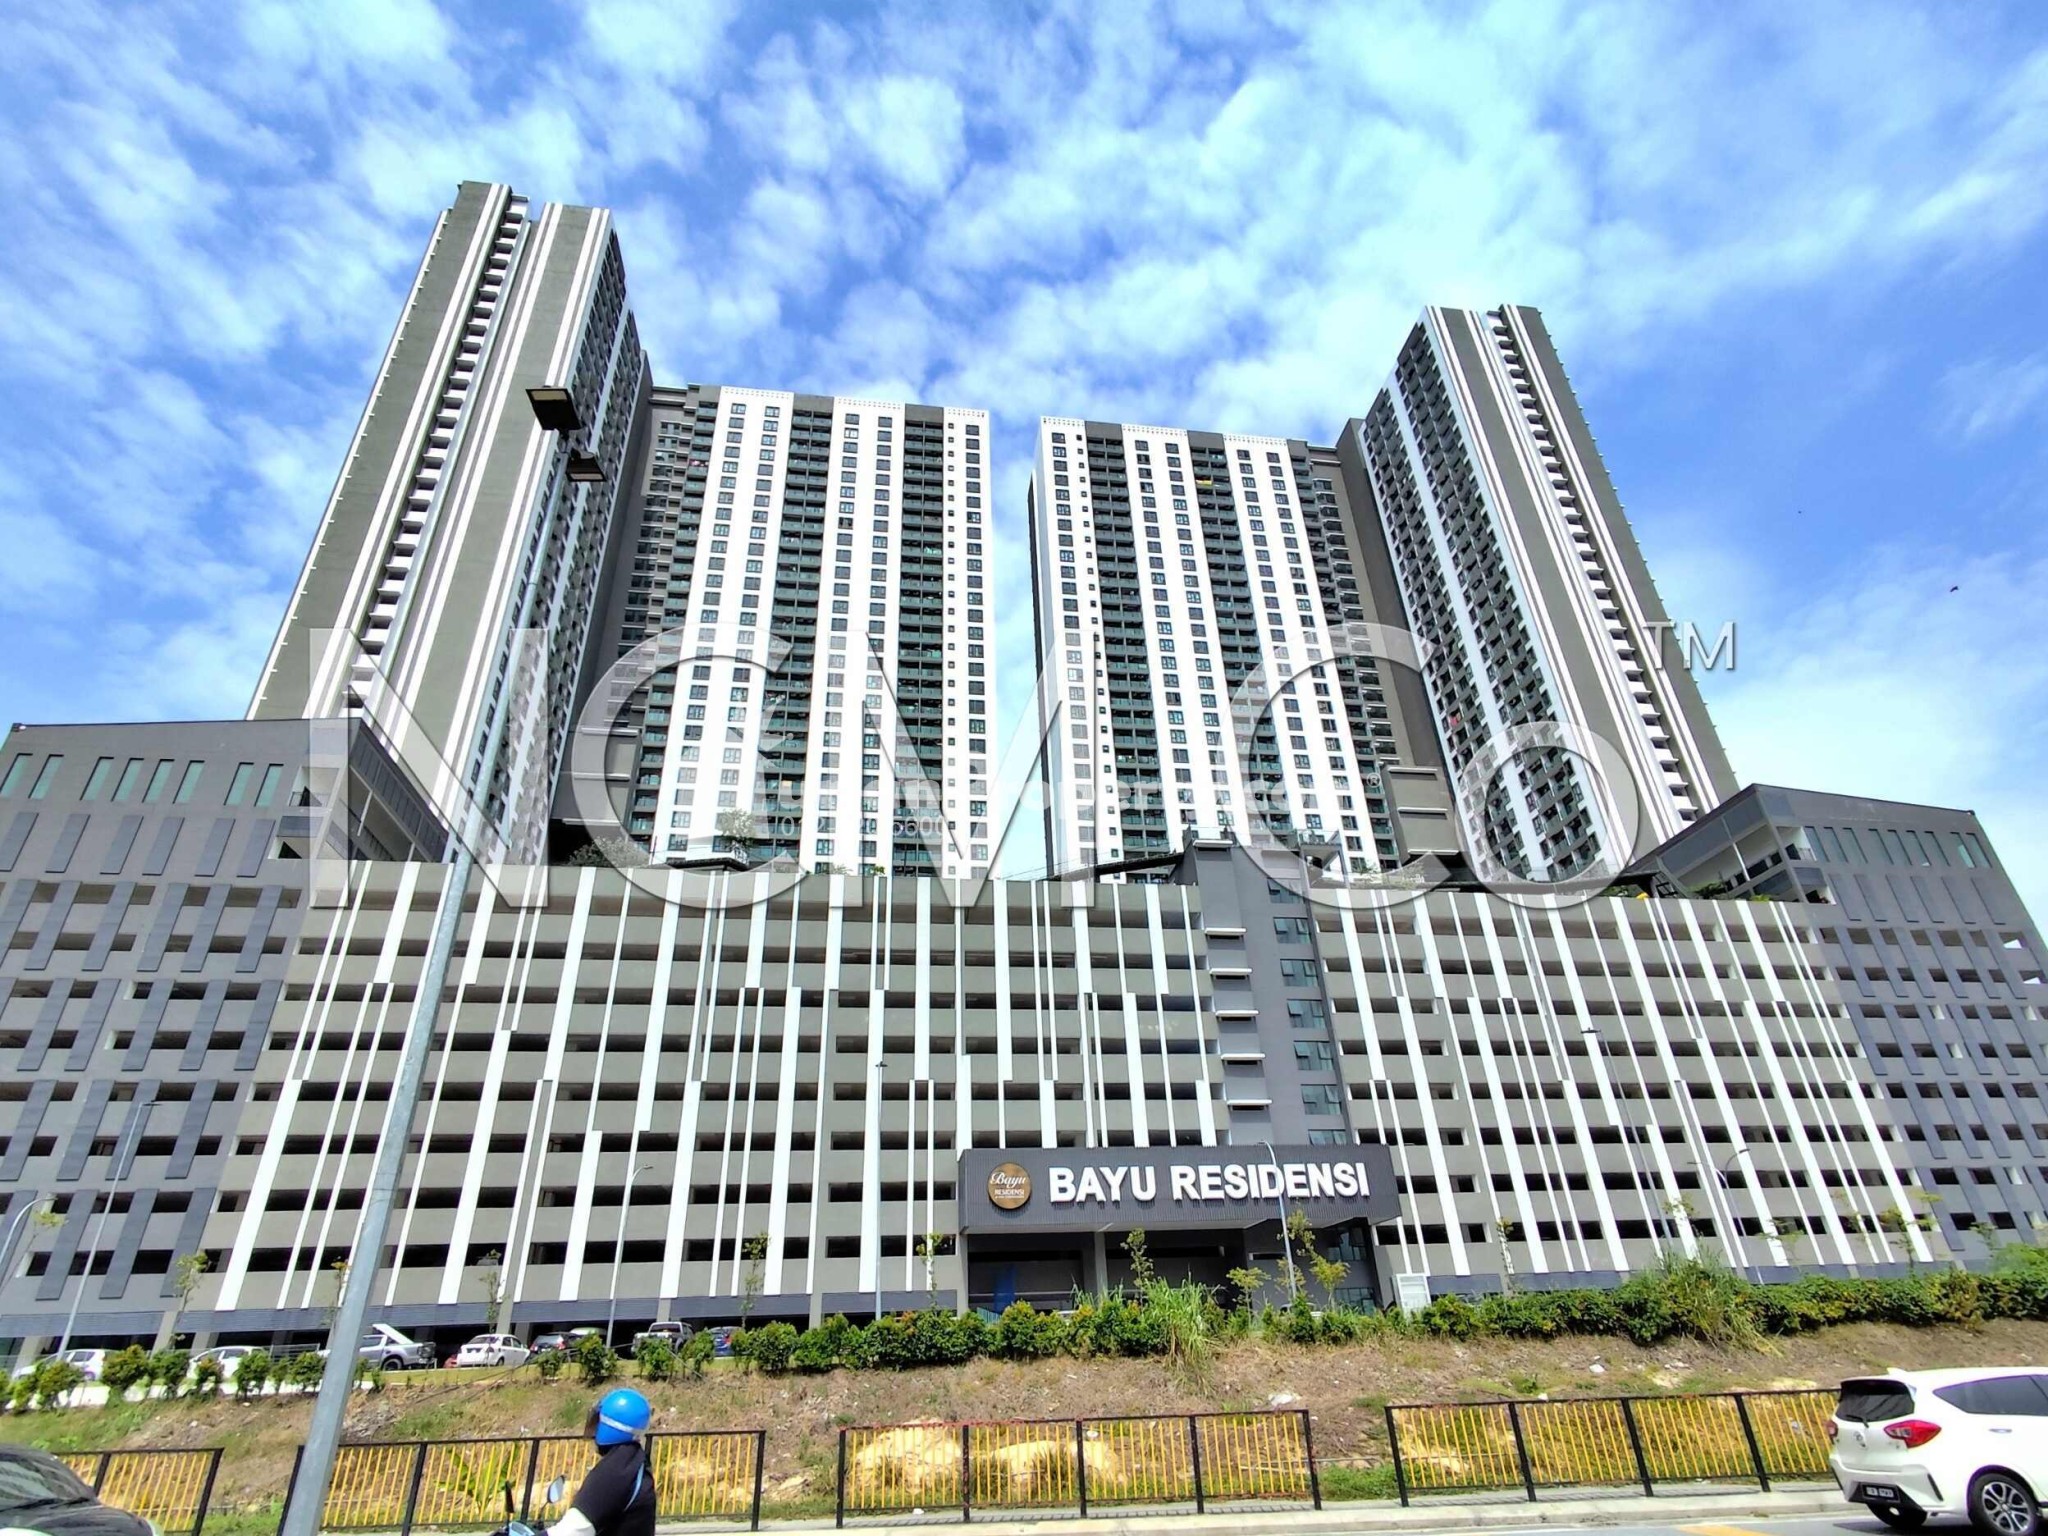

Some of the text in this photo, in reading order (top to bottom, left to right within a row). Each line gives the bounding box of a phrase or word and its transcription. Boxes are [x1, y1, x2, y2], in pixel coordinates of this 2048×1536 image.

[990, 1172, 1026, 1188] Bayu
[1049, 1162, 1370, 1203] BAYU RESIDENSI
